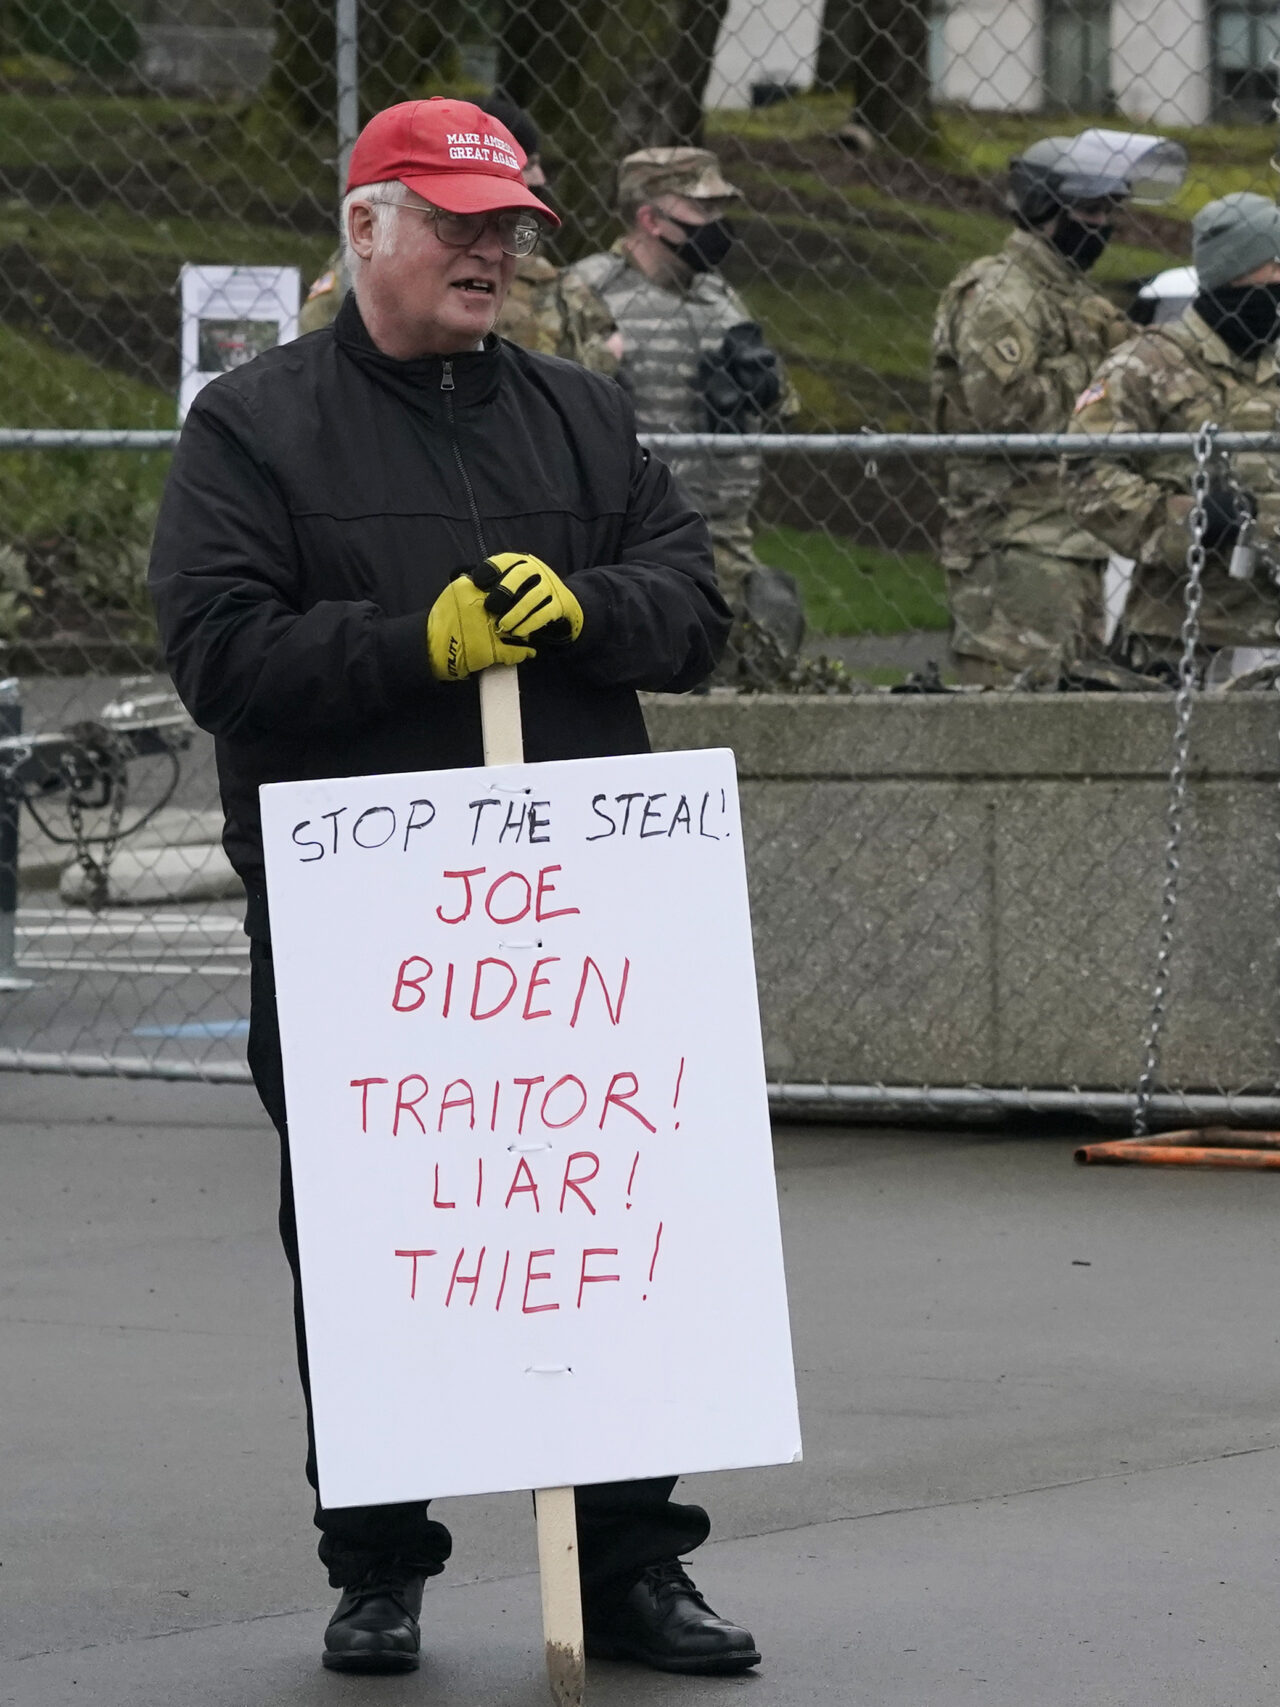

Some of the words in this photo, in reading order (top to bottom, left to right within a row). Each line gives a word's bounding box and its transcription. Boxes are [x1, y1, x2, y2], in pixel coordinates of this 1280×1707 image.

[446, 133, 481, 145] MAKE
[449, 147, 490, 161] GREAT
[292, 799, 436, 862] STOP
[469, 798, 551, 845] THE
[585, 788, 731, 842] STEAL!
[436, 864, 581, 925] JOE
[392, 956, 631, 1028] BIDEN
[350, 1056, 685, 1136] TRAITOR!
[433, 1150, 640, 1216] LIAR!
[395, 1222, 663, 1314] THIEF!
